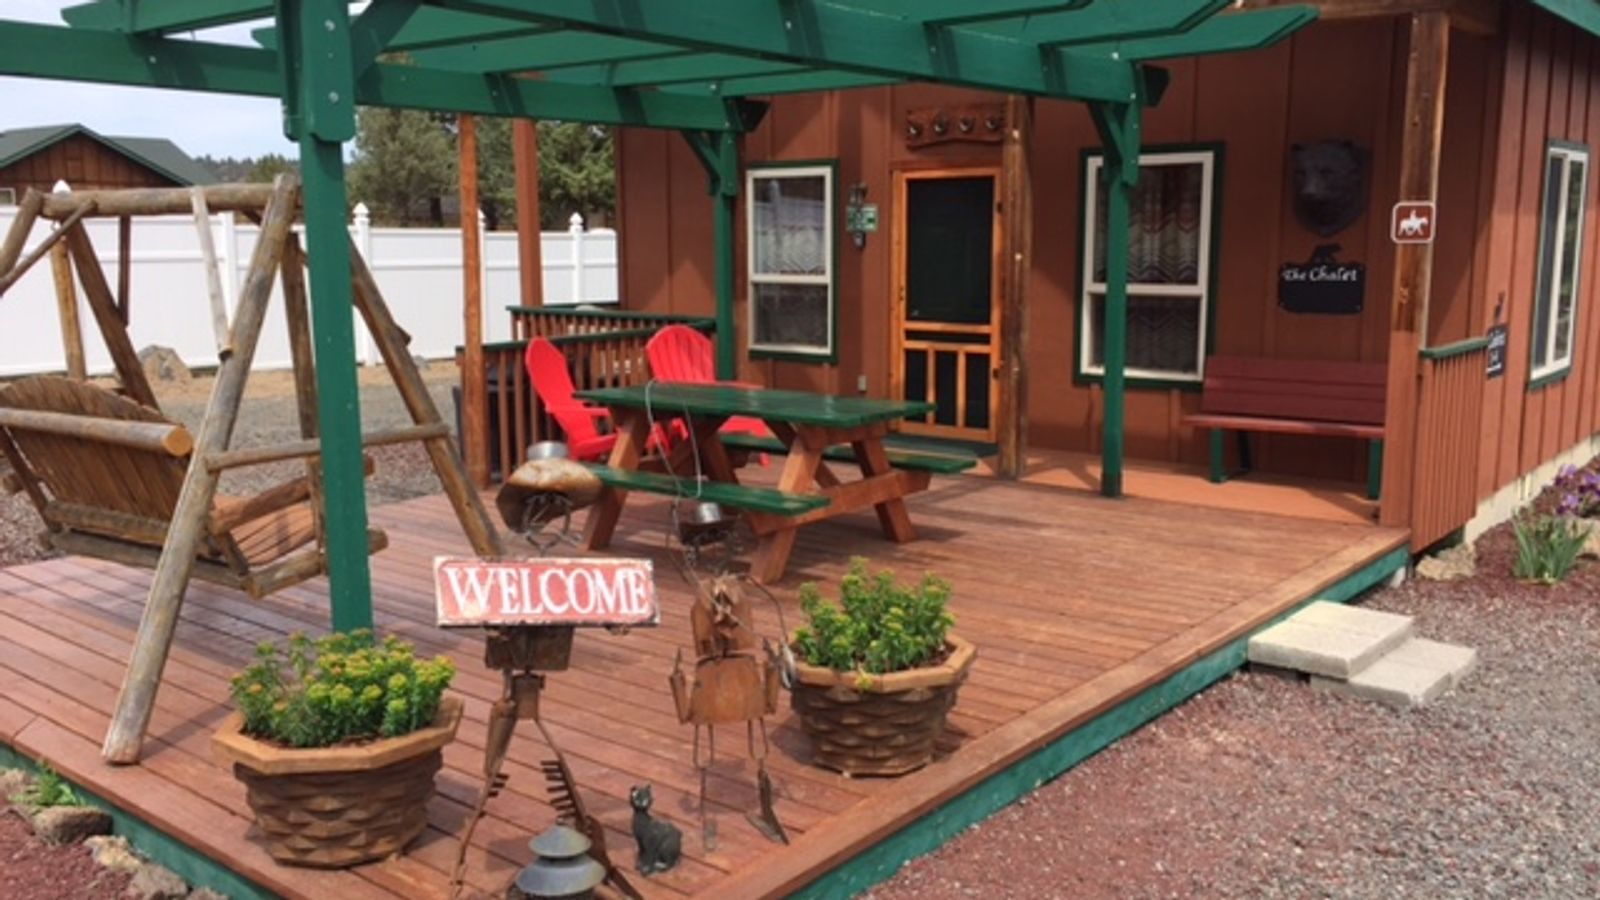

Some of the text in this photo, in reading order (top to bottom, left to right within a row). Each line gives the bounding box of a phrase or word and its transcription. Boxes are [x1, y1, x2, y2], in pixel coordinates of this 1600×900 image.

[1282, 265, 1357, 281] The Chalet
[443, 565, 649, 615] WELCOME
